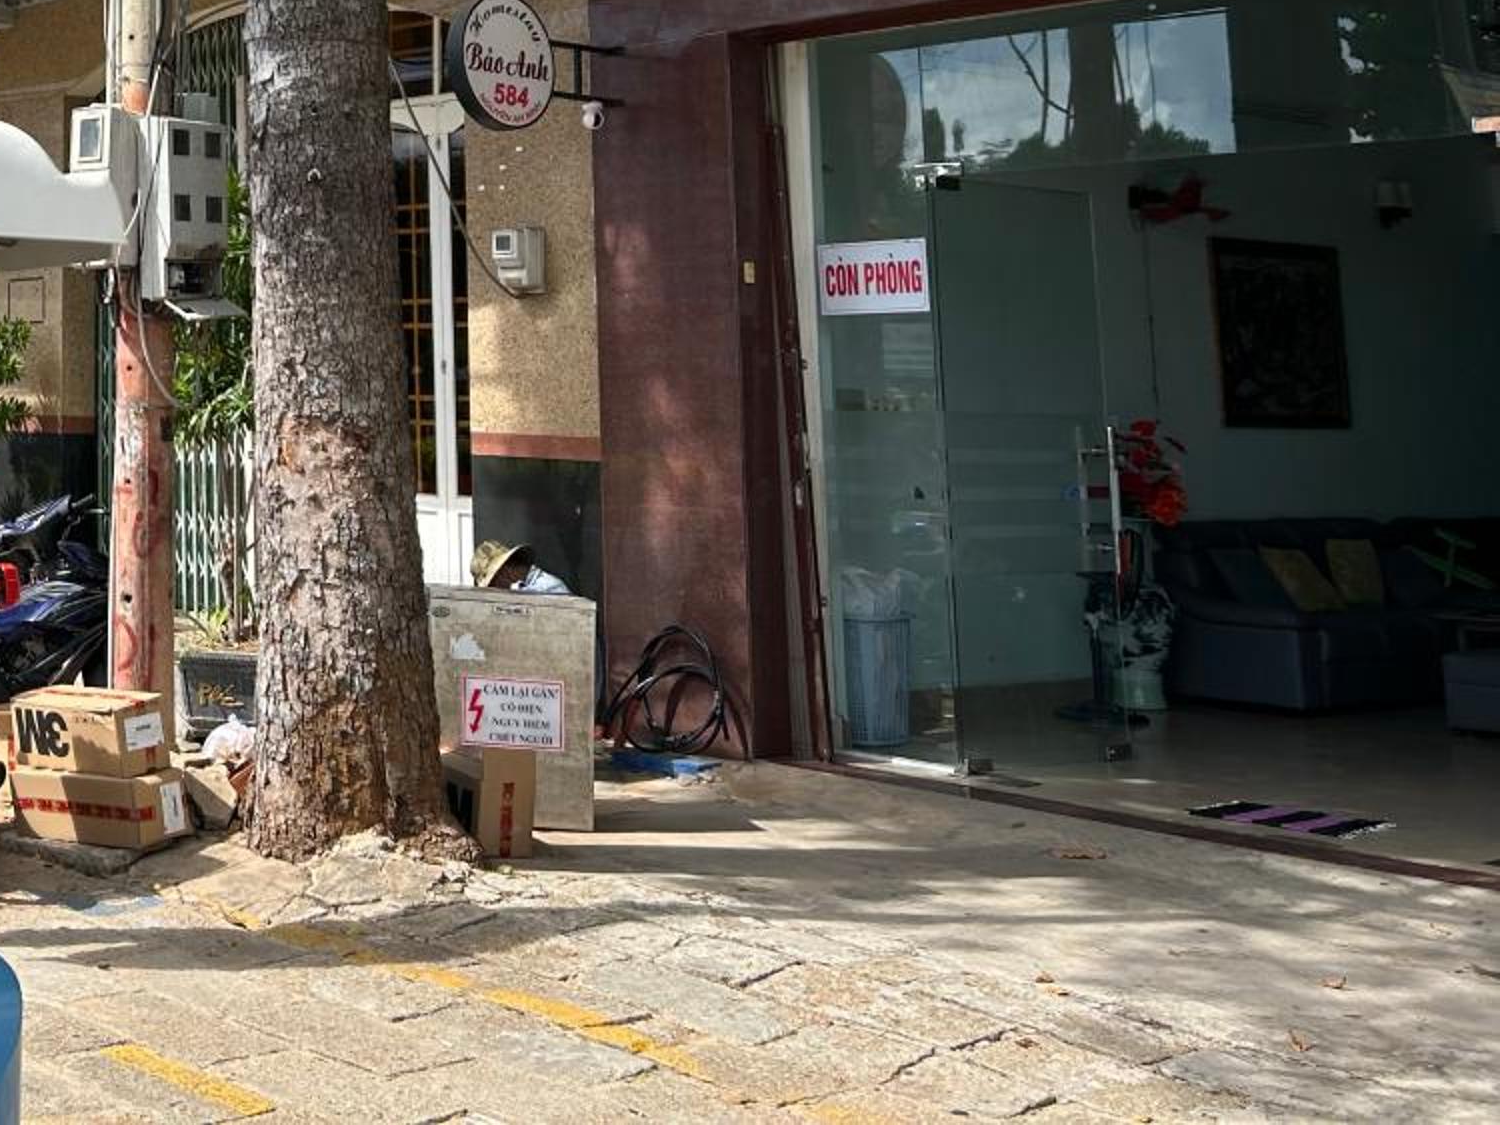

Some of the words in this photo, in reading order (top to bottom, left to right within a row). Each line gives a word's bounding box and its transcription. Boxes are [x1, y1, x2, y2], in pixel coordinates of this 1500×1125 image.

[465, 41, 504, 74] Bảo
[504, 49, 550, 82] Anh
[492, 81, 530, 109] 584
[825, 255, 859, 297] CÒN
[863, 252, 923, 296] PHÒNG
